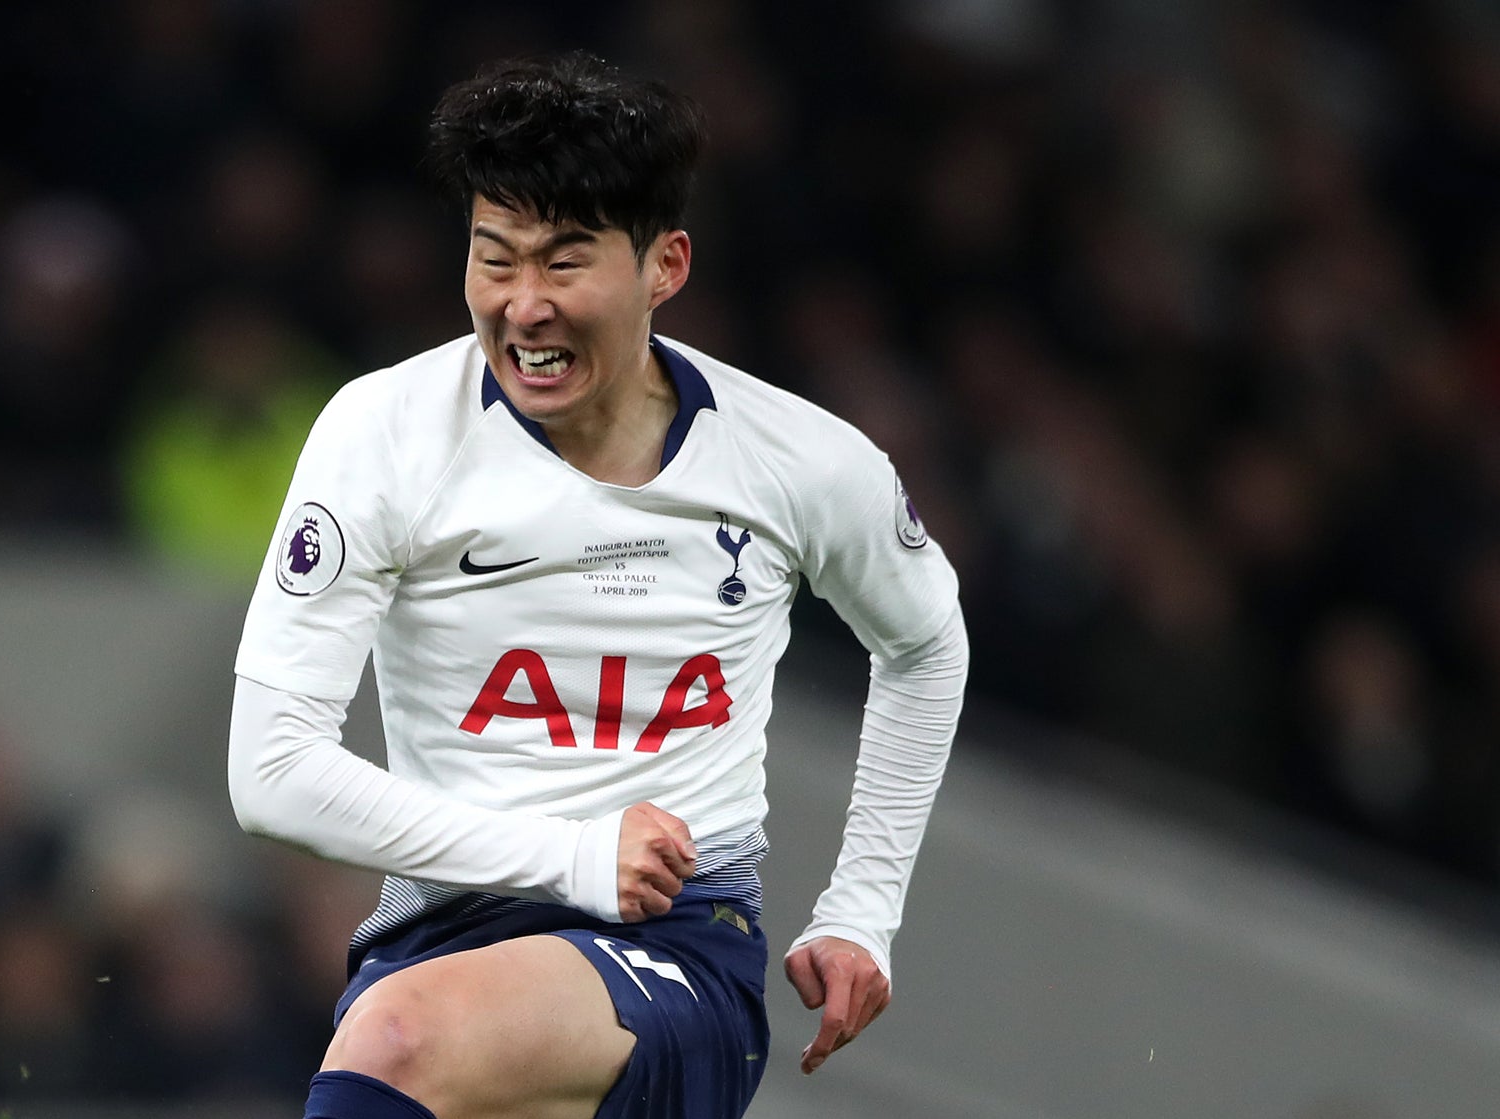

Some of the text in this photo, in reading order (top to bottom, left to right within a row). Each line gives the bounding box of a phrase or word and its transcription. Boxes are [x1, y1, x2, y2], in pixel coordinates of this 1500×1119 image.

[584, 539, 665, 553] INAUGURAL MATCH
[577, 550, 670, 565] TOTTENHAM HOTSPUR
[615, 562, 626, 570] VS
[583, 573, 657, 583] CRYSTAL PALACE
[593, 586, 648, 596] 3 APRIL 2019
[458, 648, 734, 753] AIA
